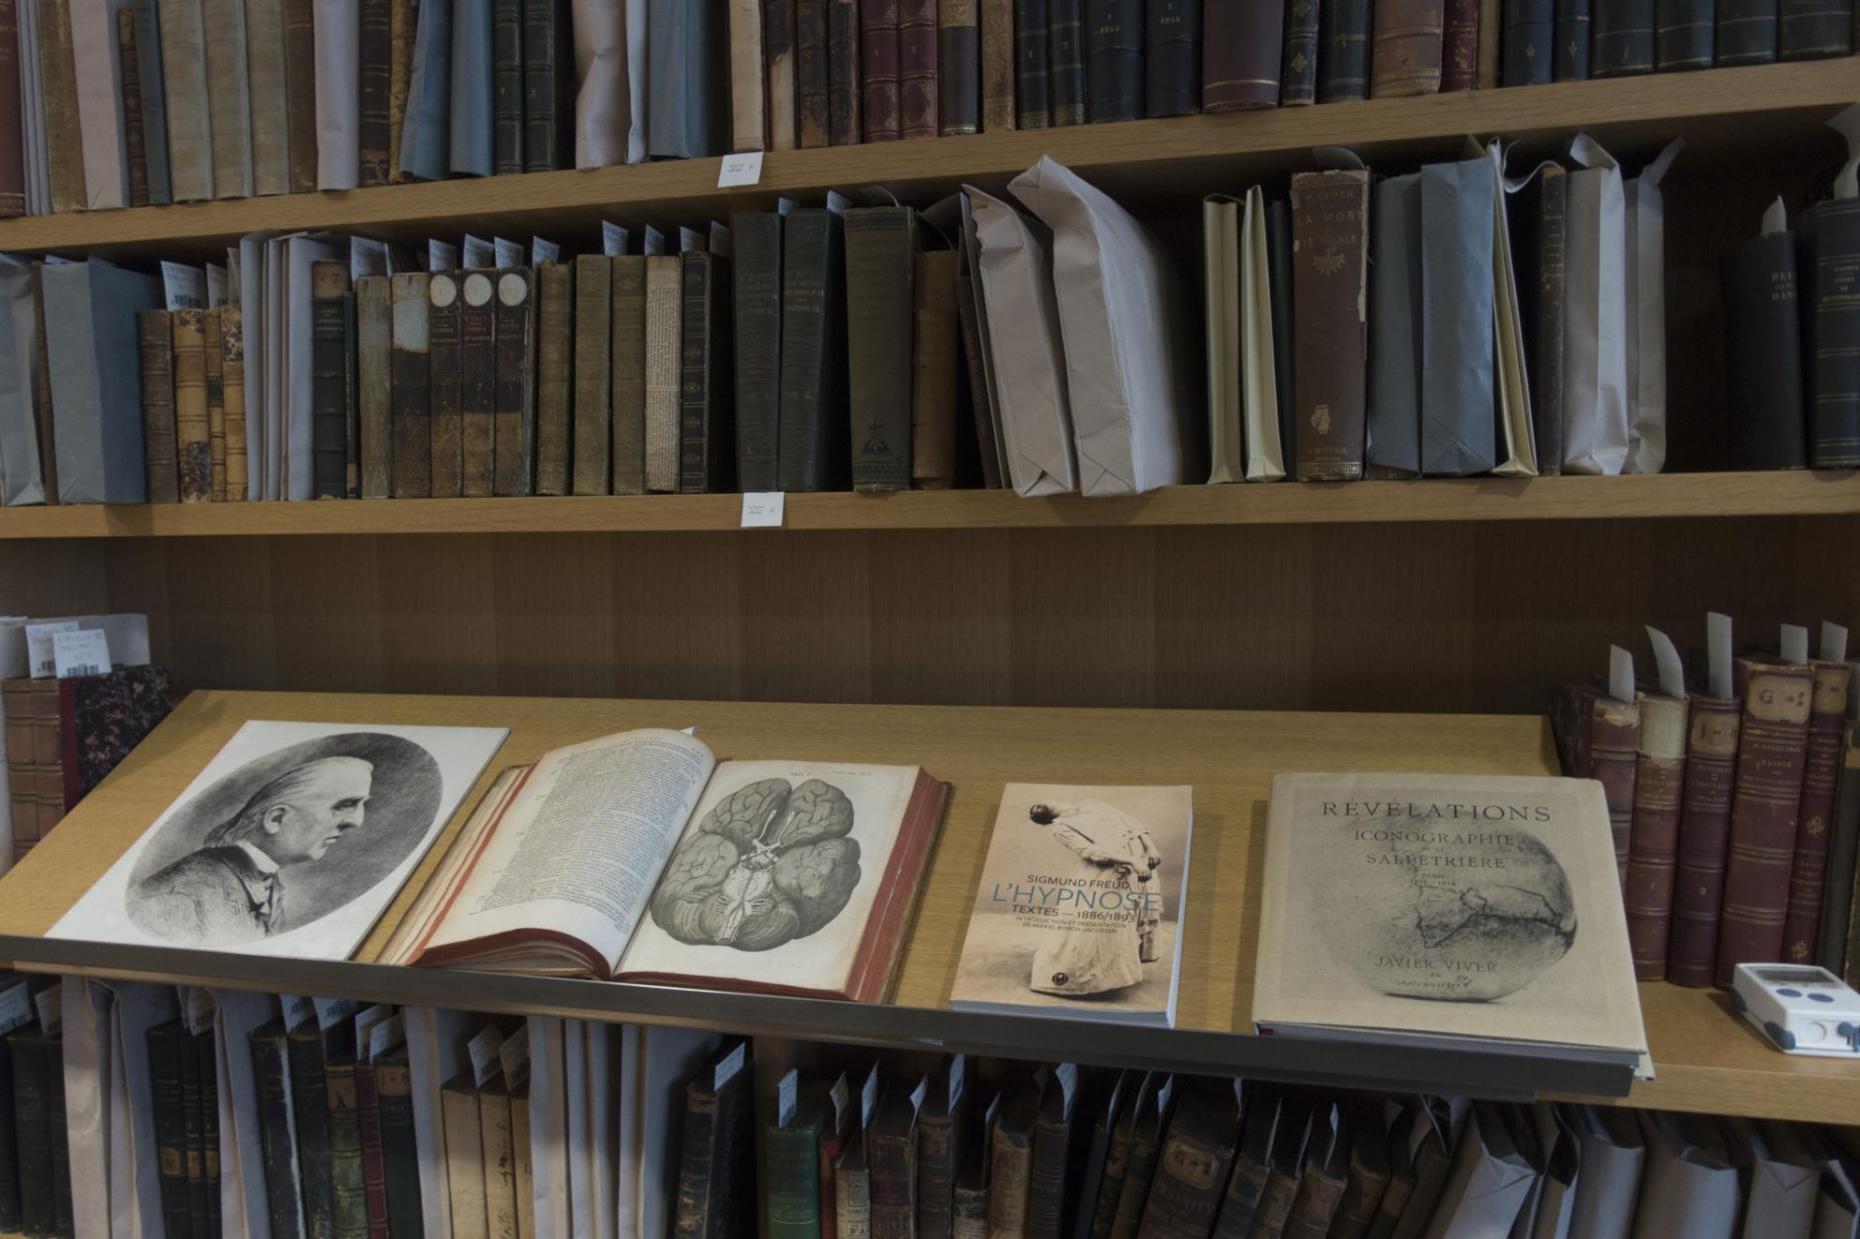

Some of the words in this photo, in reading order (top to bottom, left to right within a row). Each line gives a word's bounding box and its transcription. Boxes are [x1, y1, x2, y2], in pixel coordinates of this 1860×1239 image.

[1322, 798, 1551, 822] RÉVÉLATIONS
[1354, 829, 1515, 846] ICONOGRAPHIE
[1026, 874, 1088, 888] SIGMUND
[1088, 879, 1131, 890] FREUD
[992, 882, 1161, 913] L'HYPNOSE
[1012, 904, 1060, 917] TEXTES
[1076, 911, 1137, 924] 1886/1893
[1373, 956, 1434, 970] JAVIER
[1444, 960, 1498, 973] VIVER
